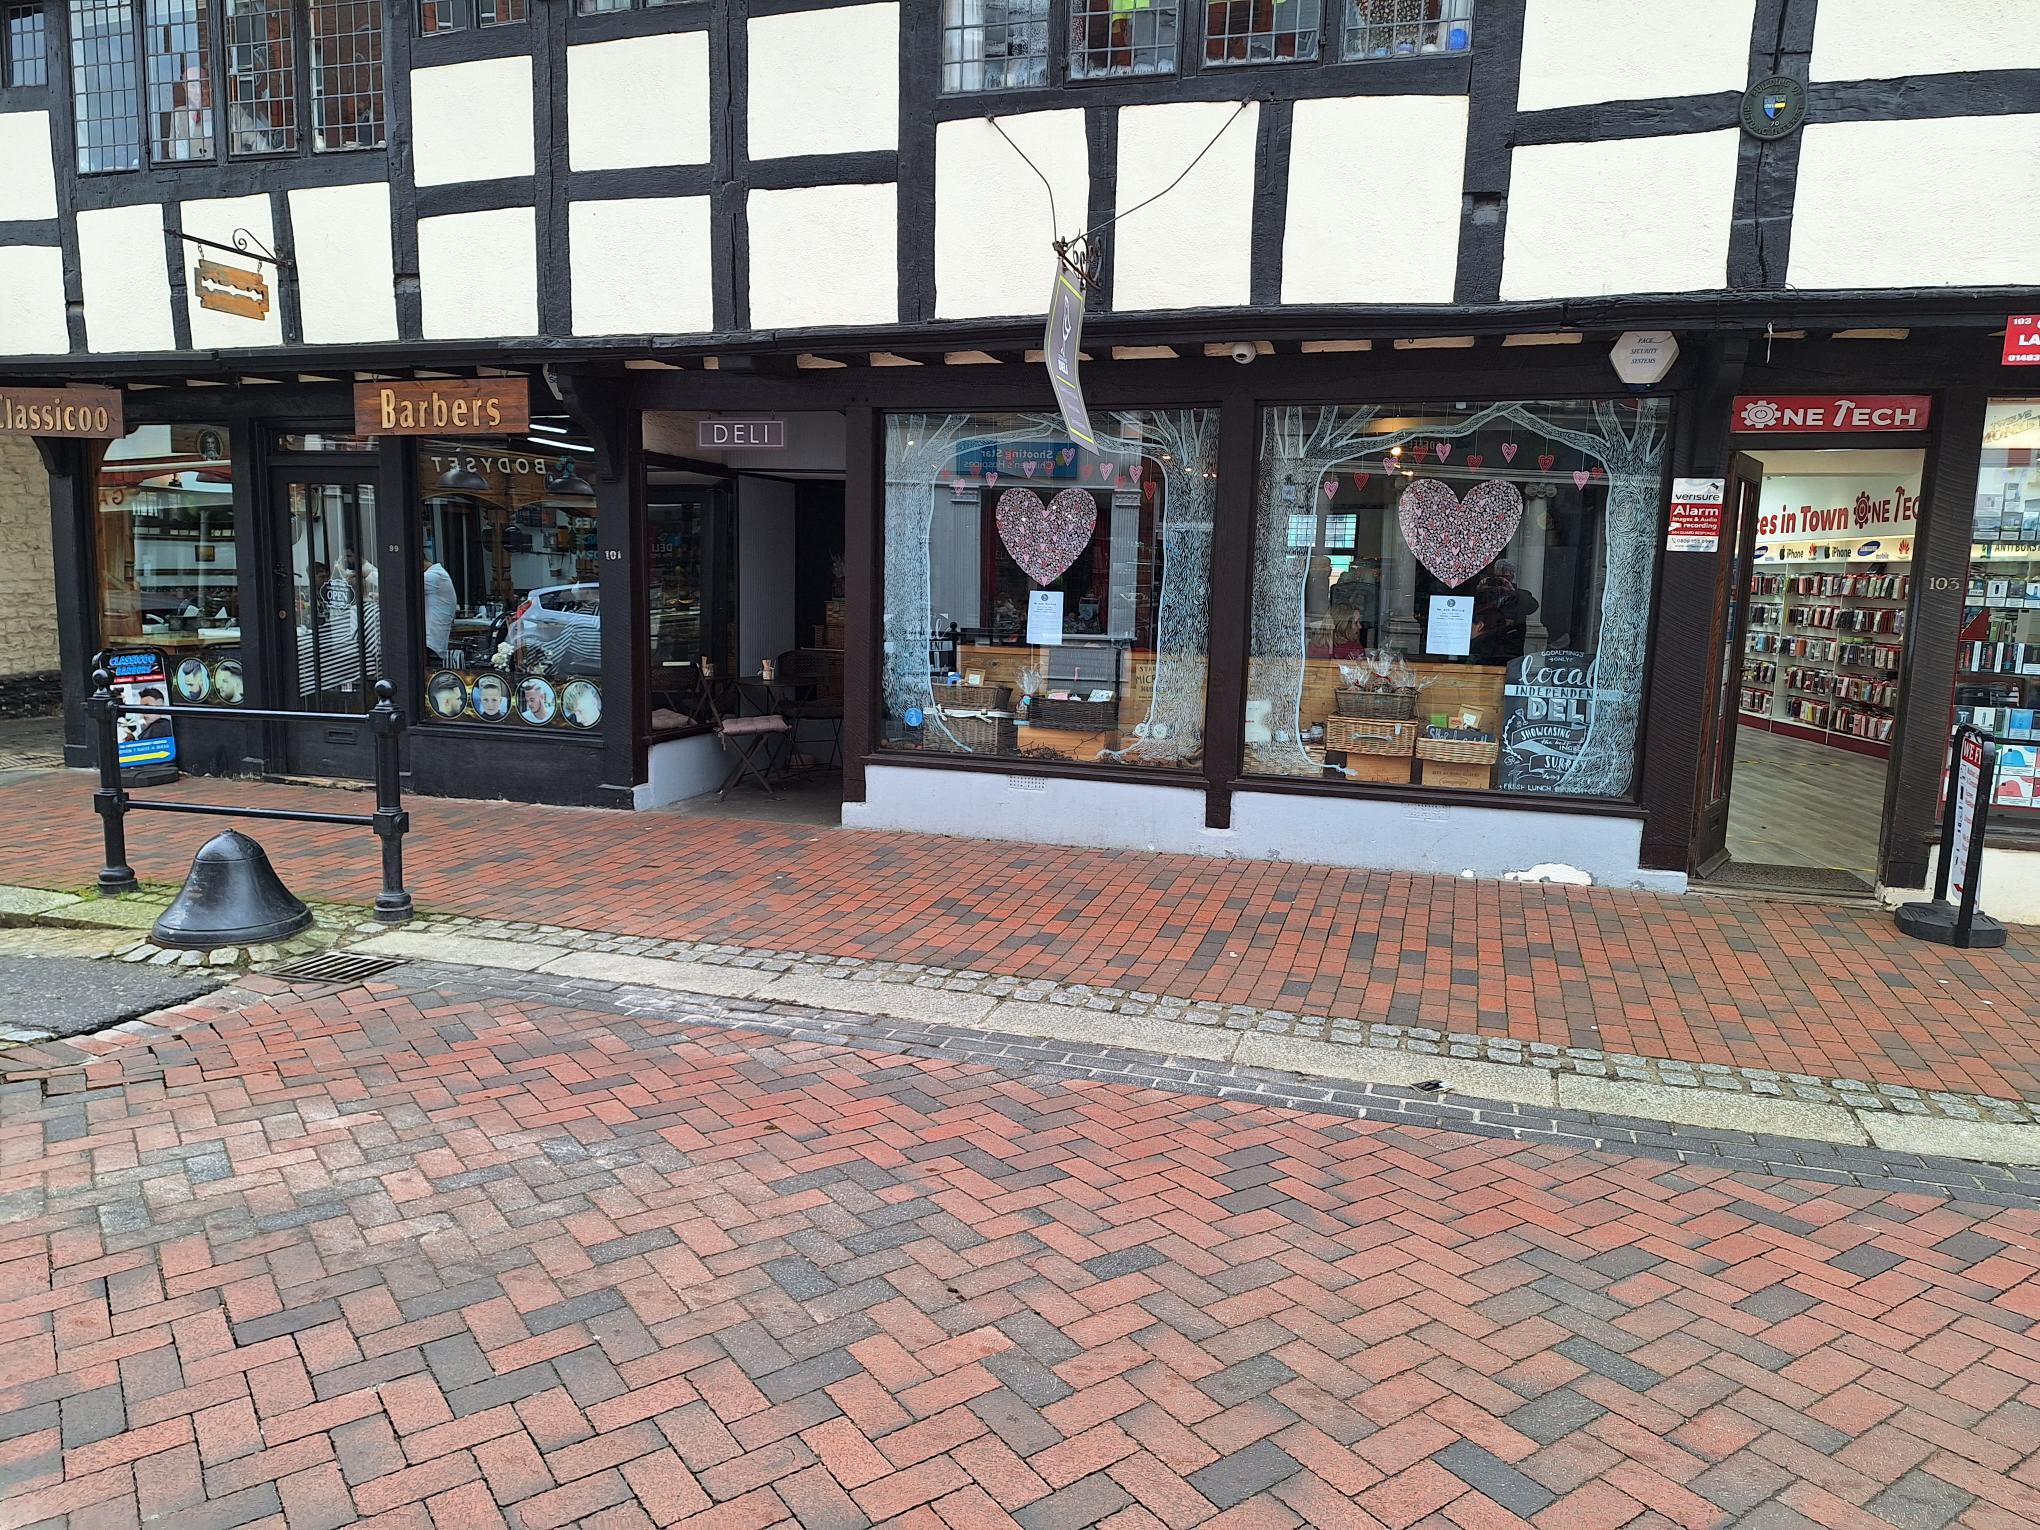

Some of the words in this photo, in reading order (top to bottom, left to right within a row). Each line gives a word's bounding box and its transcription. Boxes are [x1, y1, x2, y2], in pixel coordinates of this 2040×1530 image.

[1751, 79, 1791, 97] BUILDING
[2013, 317, 2032, 325] 103
[380, 388, 501, 429] Barbers
[714, 424, 768, 443] DELI
[1675, 493, 1720, 501] verisure
[1673, 504, 1718, 516] Alarm
[1781, 505, 1796, 533] in
[1801, 505, 1848, 532] Town
[605, 551, 621, 560] 101
[1786, 548, 1804, 558] iPhone
[1832, 547, 1852, 557] iPhone
[1929, 578, 1960, 590] 103
[327, 592, 348, 600] OPEN
[1515, 685, 1600, 699] INDEPENDEN
[1527, 697, 1593, 723] DELI
[1520, 727, 1571, 740] SHOWCASING
